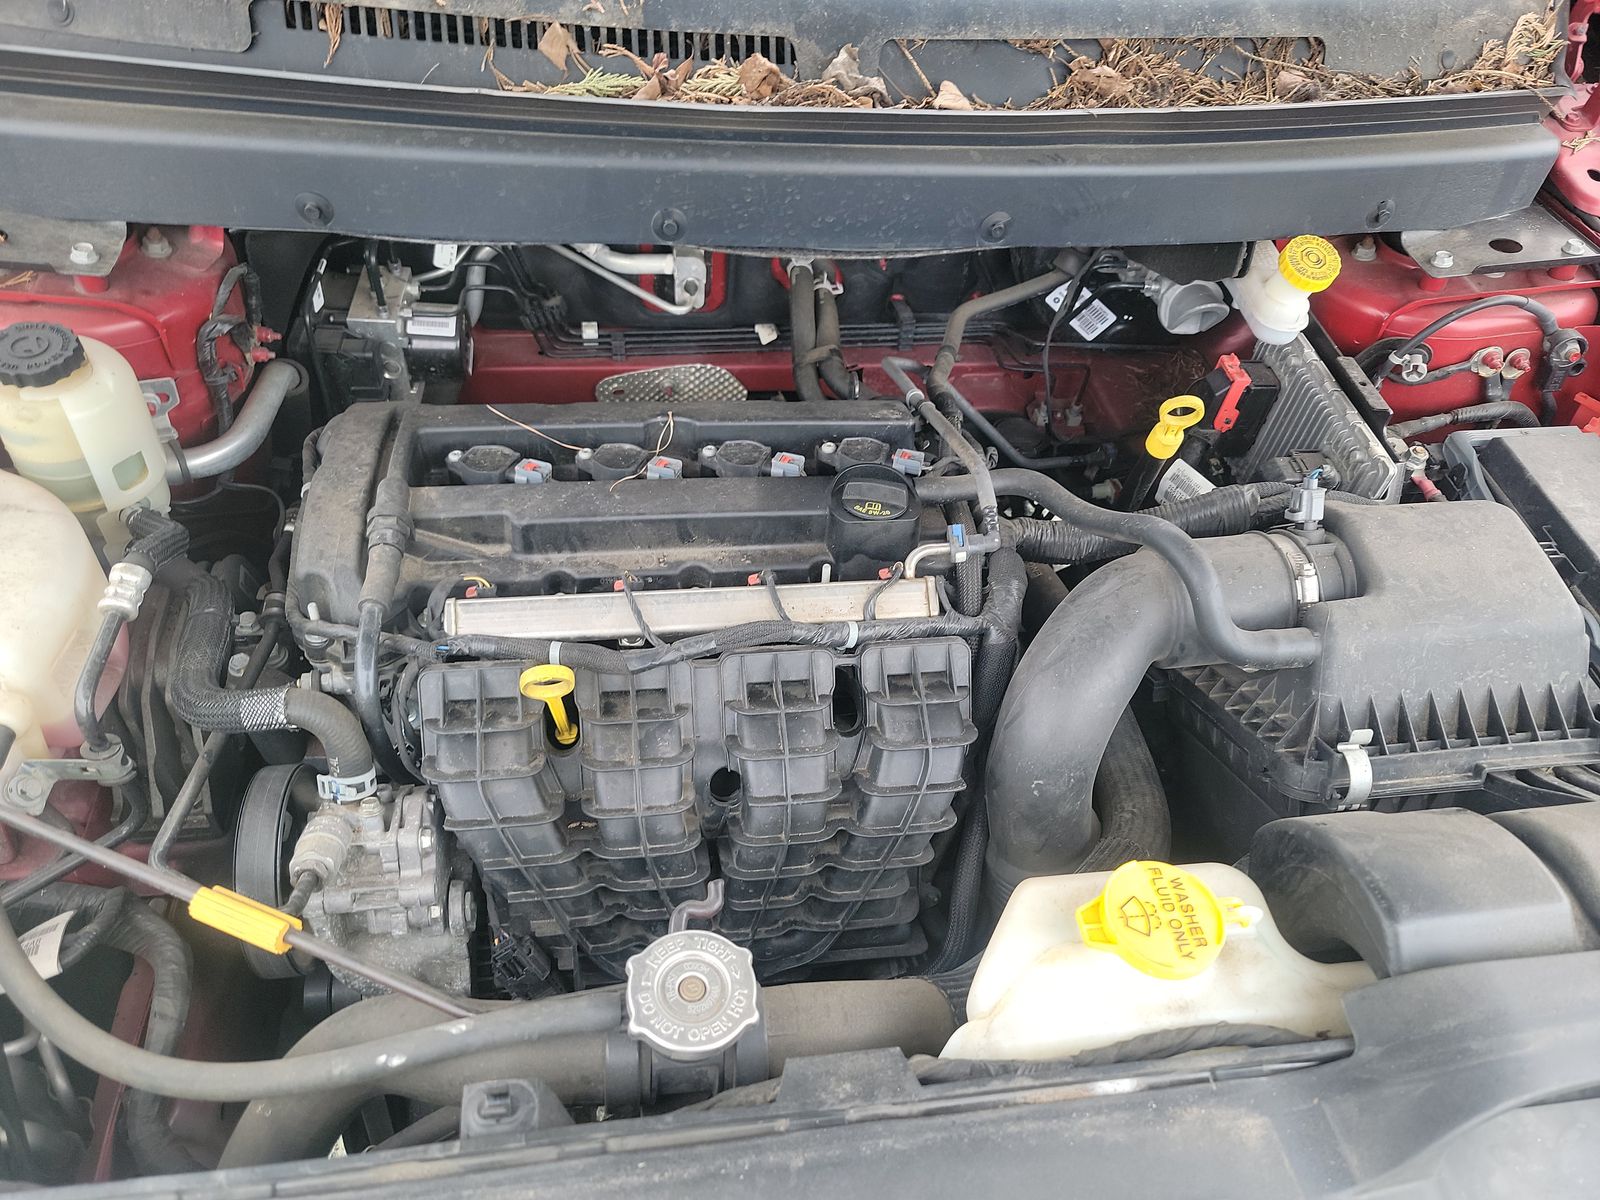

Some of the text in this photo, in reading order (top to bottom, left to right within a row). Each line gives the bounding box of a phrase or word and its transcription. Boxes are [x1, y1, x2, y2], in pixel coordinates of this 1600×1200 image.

[1148, 867, 1196, 960] FLUID ONLY
[1170, 877, 1208, 948] WASHER
[645, 939, 685, 969] KEEP
[694, 936, 737, 962] TIGHT
[638, 992, 656, 1015] DO
[650, 1016, 684, 1039] NOT
[688, 1016, 733, 1041] OPEN
[727, 986, 748, 1018] HOT
